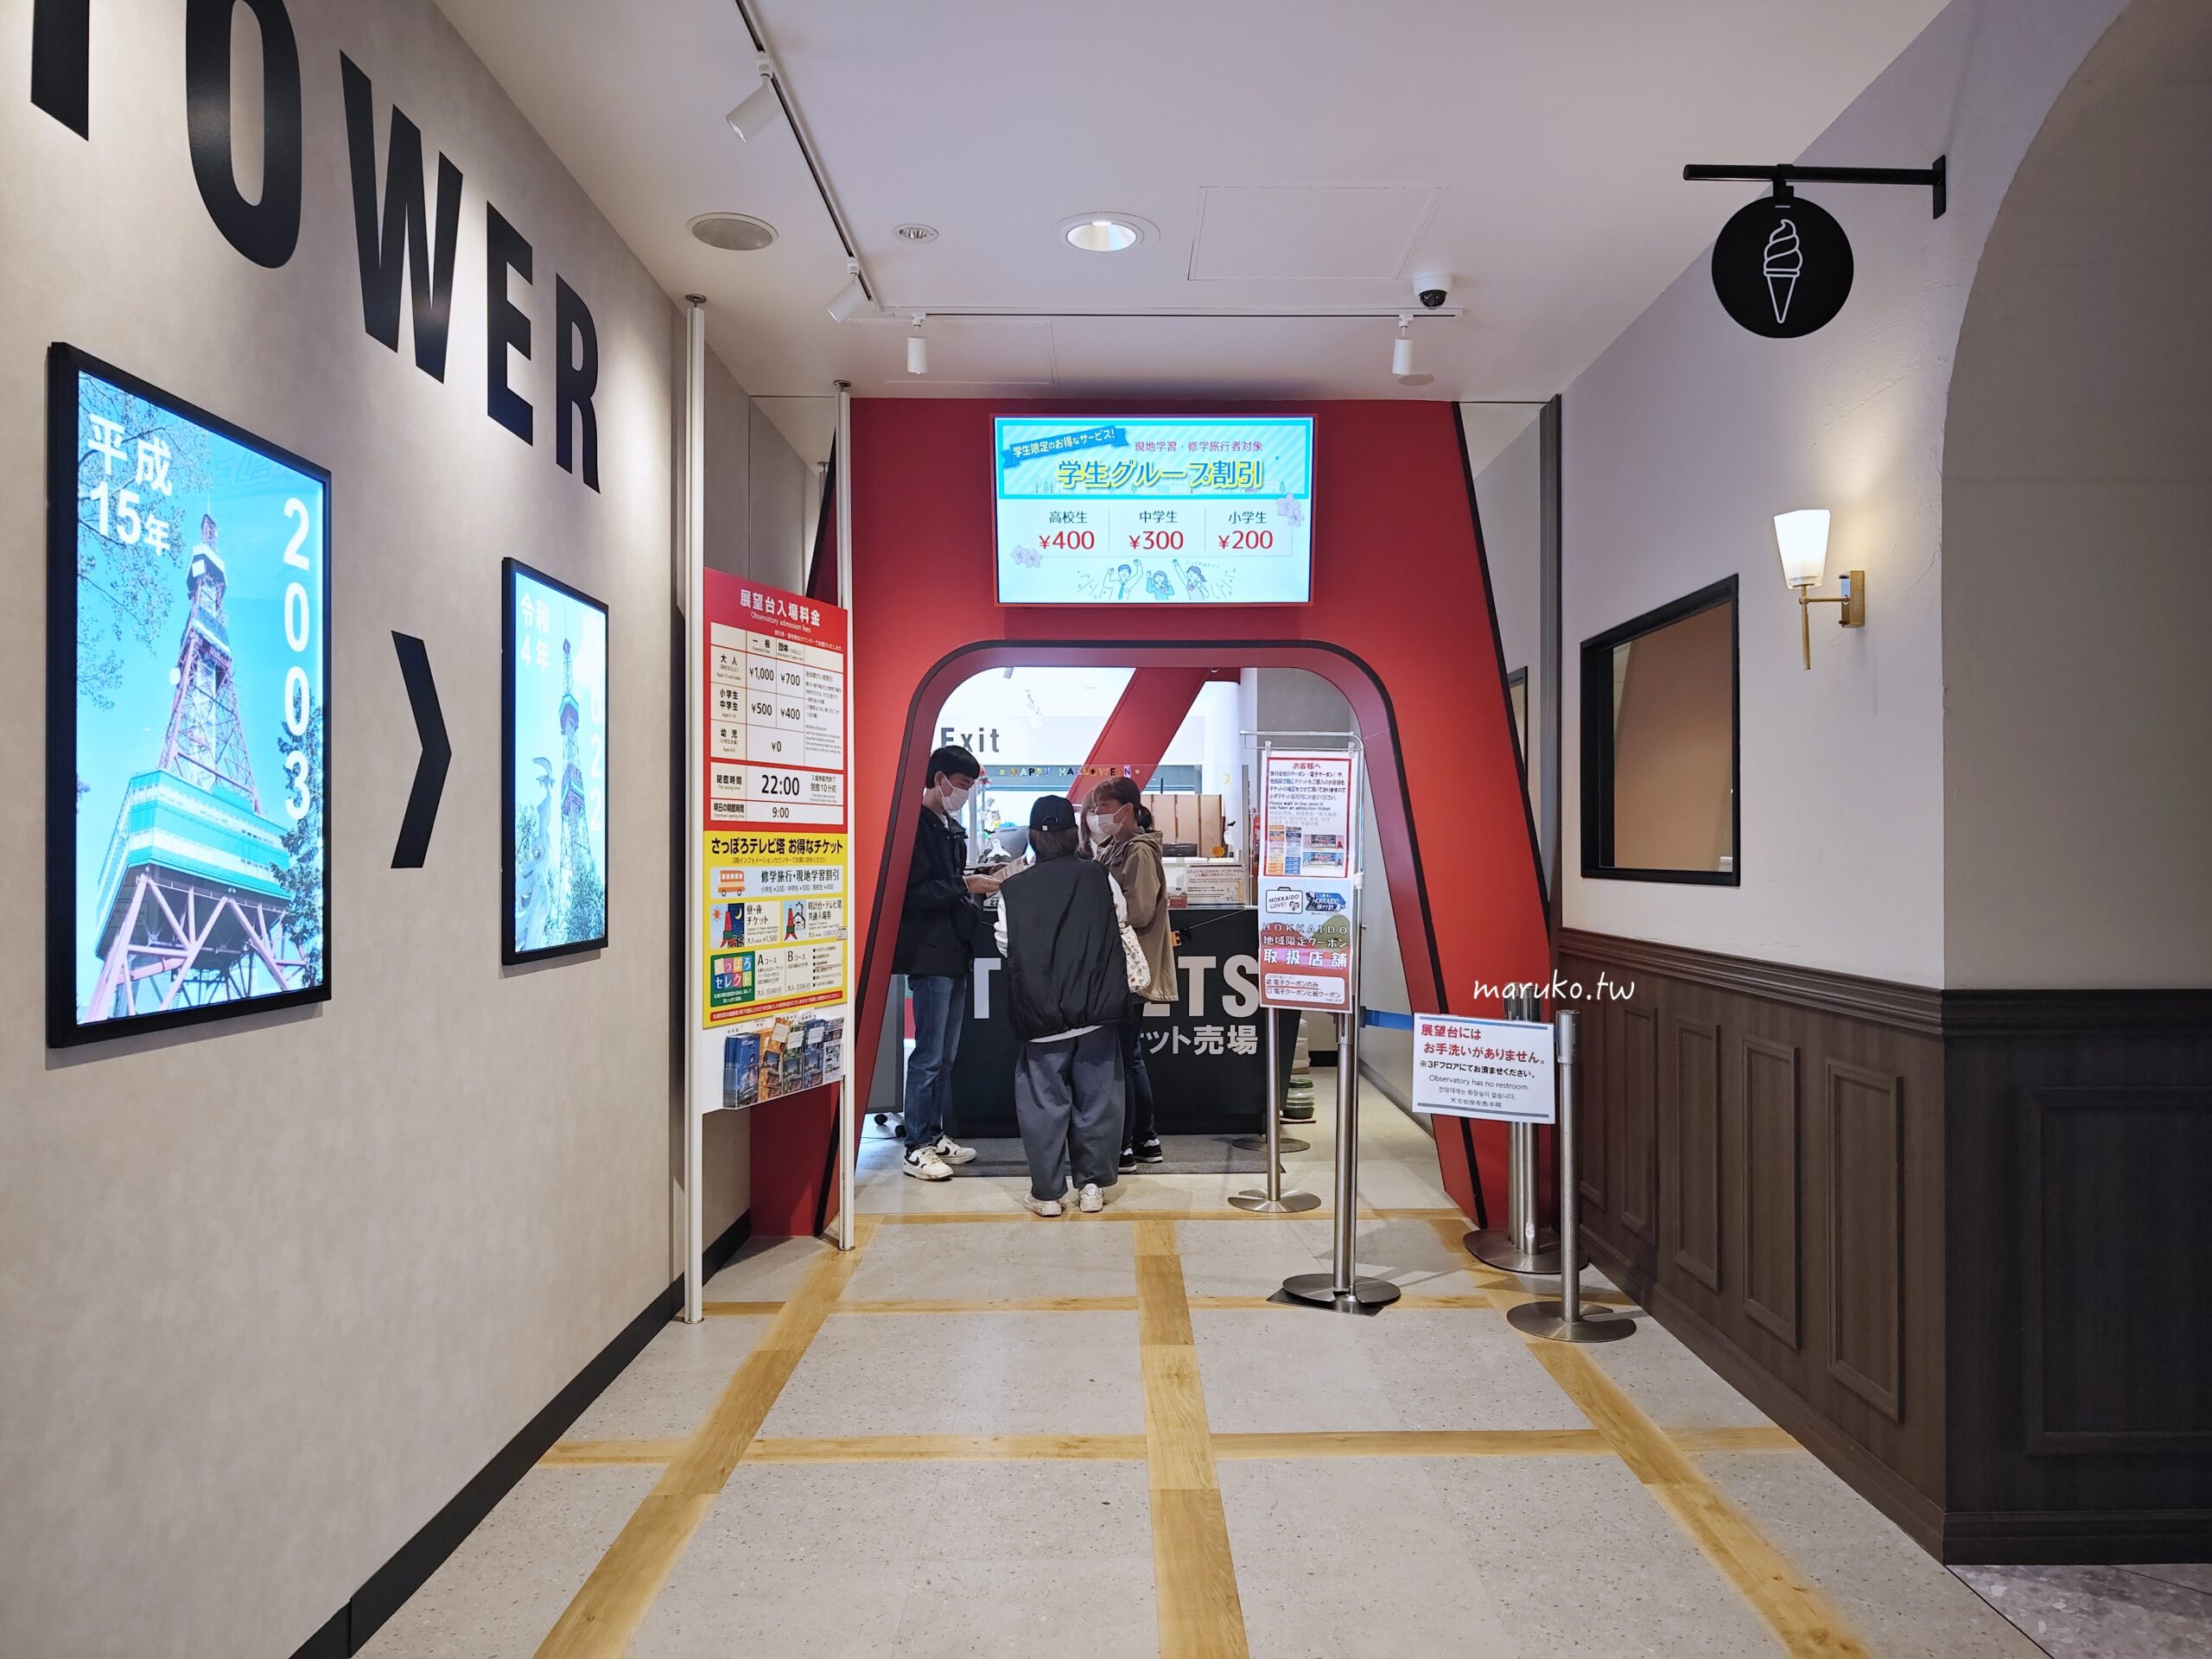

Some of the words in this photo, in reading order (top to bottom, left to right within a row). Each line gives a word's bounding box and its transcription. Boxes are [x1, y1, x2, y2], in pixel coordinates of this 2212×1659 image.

[87, 414, 173, 498] 平成
[1058, 460, 1263, 488] 学生グループ割引
[90, 484, 172, 556] 15年
[1049, 511, 1088, 524] 高校生
[1139, 510, 1179, 524] 中学生
[1228, 511, 1268, 524] 小学生
[1039, 531, 1095, 550] ¥400
[1128, 531, 1184, 550] ¥300
[1217, 531, 1274, 550] ¥200
[520, 593, 550, 637] 令和
[740, 588, 821, 627] 展望台入場料金
[750, 611, 779, 626] Observatory
[283, 497, 312, 822] 2003
[521, 635, 550, 673] 4年
[749, 666, 774, 681] ¥1,000
[781, 673, 800, 686] ¥700
[720, 689, 739, 700] 小学生
[720, 700, 739, 711] 中学生
[752, 702, 772, 716] ¥500
[781, 708, 800, 721] ¥400
[772, 741, 782, 753] ¥0
[940, 728, 1000, 753] Exit
[1009, 766, 1051, 777] HAPPY
[1058, 766, 1132, 777] HALLOWEEN
[761, 774, 800, 796] 22:00
[772, 806, 790, 818] 9:00
[711, 837, 785, 855] さっぽろテレビ塔
[788, 838, 843, 855] お得なチケット
[760, 868, 840, 883] 修学旅行・現地学習割引
[1269, 893, 1300, 903] HOKKAIDO
[747, 916, 768, 925] チケット
[1262, 923, 1348, 934] HOKKAIDO
[1263, 936, 1348, 949] 地域限定クーポン
[1263, 949, 1348, 969] 取扱店舗
[1274, 979, 1319, 988] 電子クーポンのみ
[1141, 1025, 1258, 1055] ット売場
[1421, 1024, 1482, 1040] 展望台には
[1423, 1041, 1546, 1065] お手洗いがありません。
[1428, 1074, 1471, 1086] Observatory
